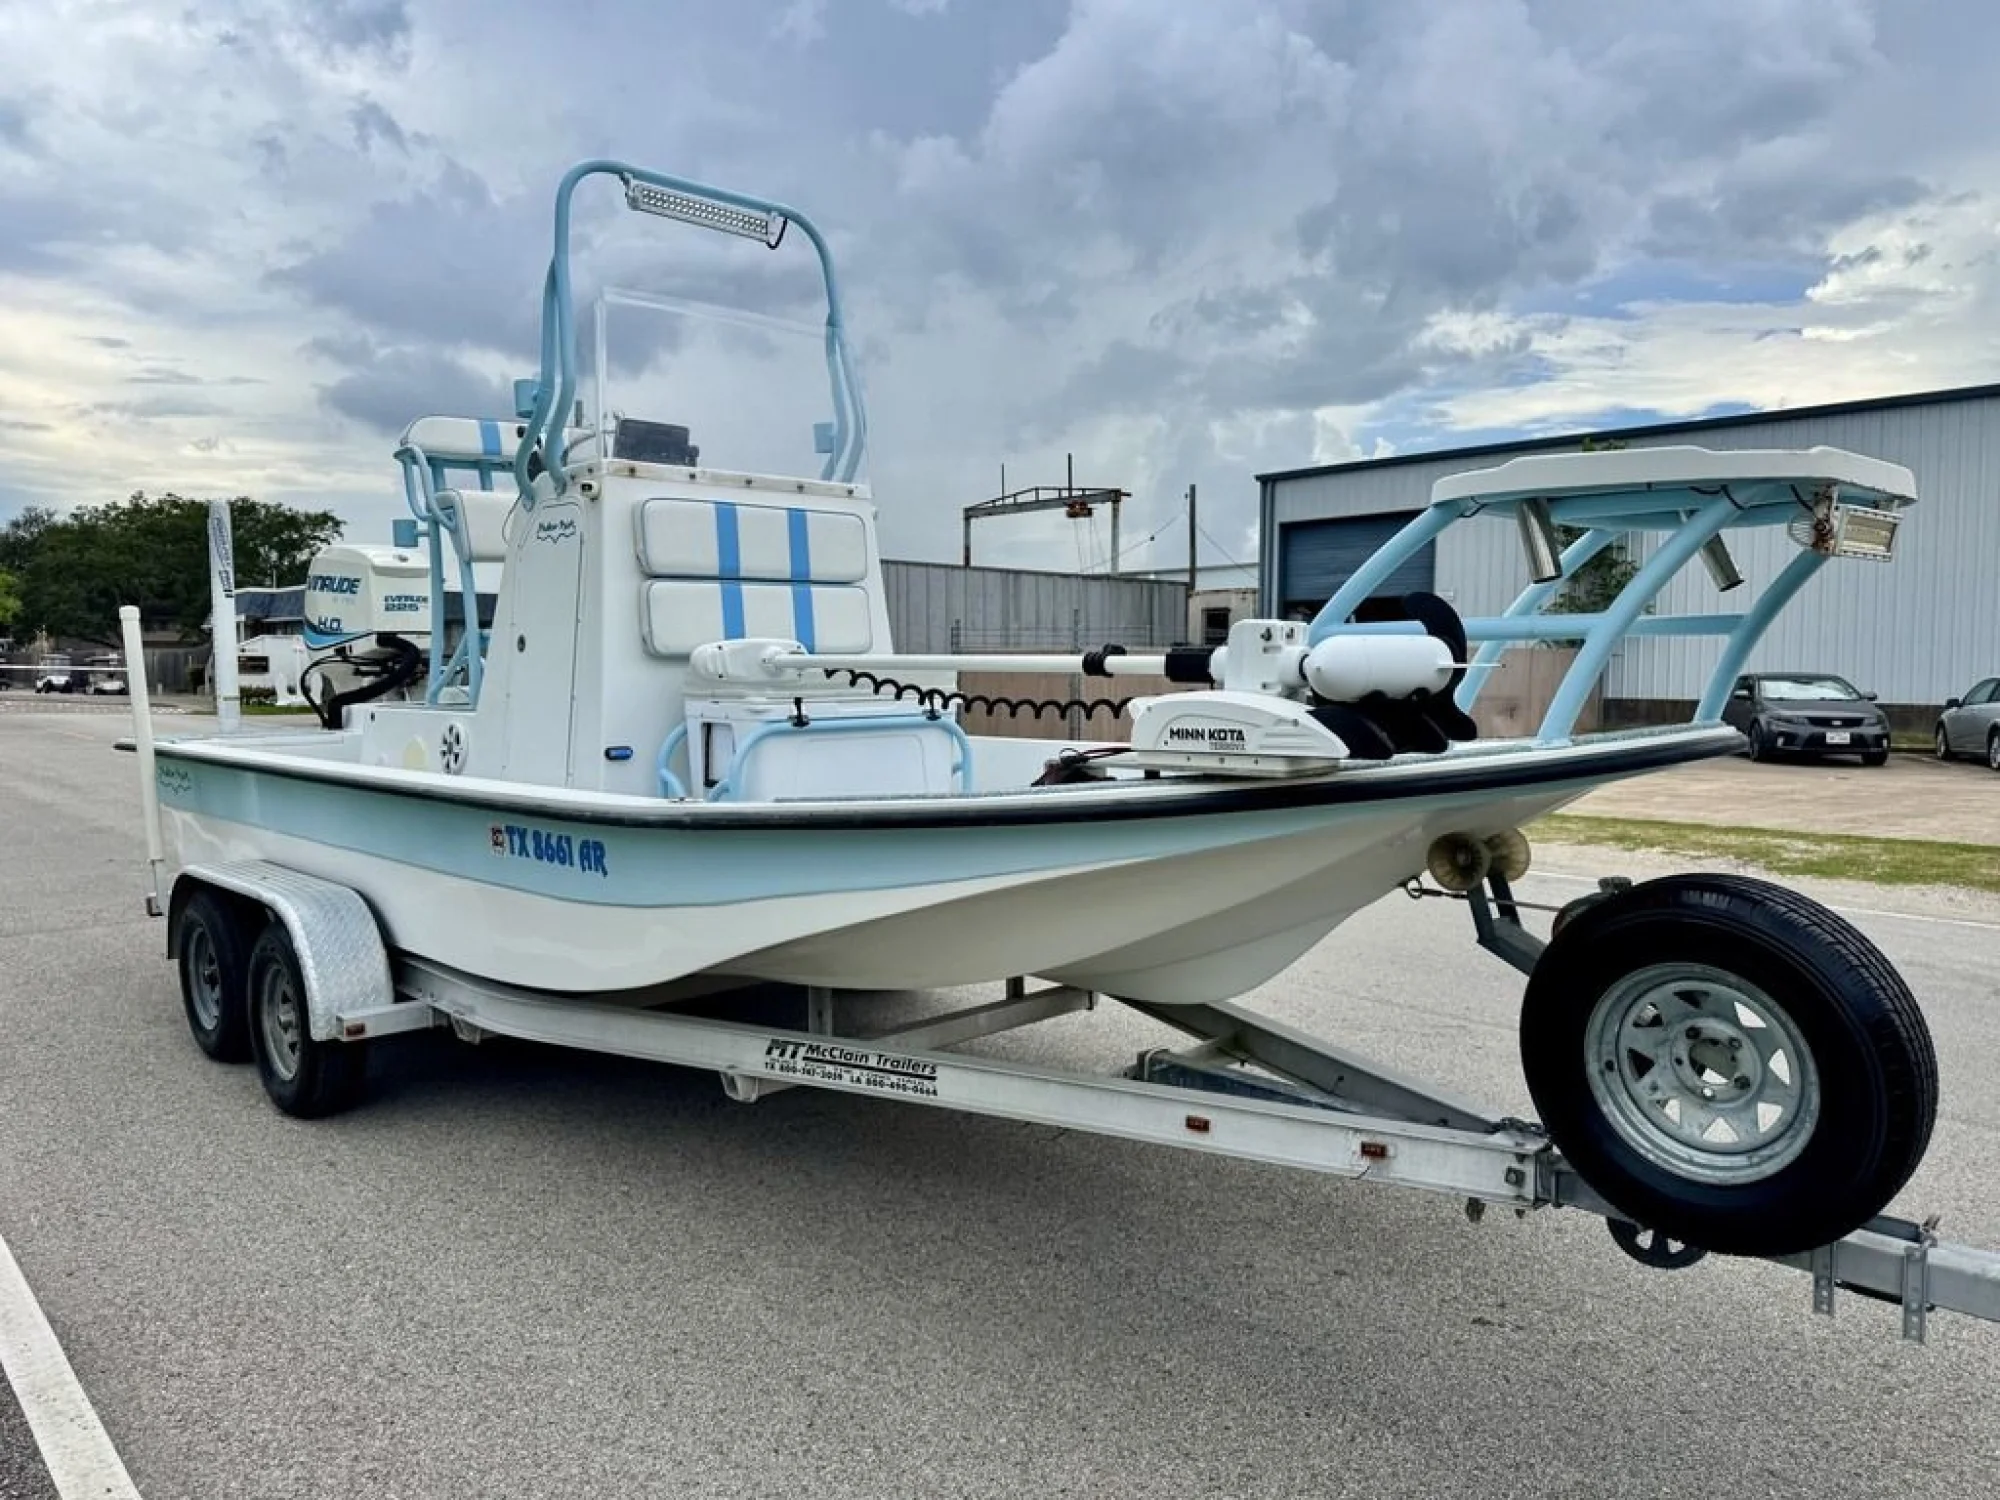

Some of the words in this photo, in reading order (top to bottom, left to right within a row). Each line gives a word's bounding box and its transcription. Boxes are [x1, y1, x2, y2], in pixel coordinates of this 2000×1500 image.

[1169, 727, 1205, 740] MINN
[1208, 728, 1245, 741] KOTA
[505, 825, 530, 858] TX
[532, 829, 575, 868] 8661
[579, 839, 609, 878] AR
[805, 1045, 869, 1064] McClain
[876, 1053, 937, 1075] Trailers
